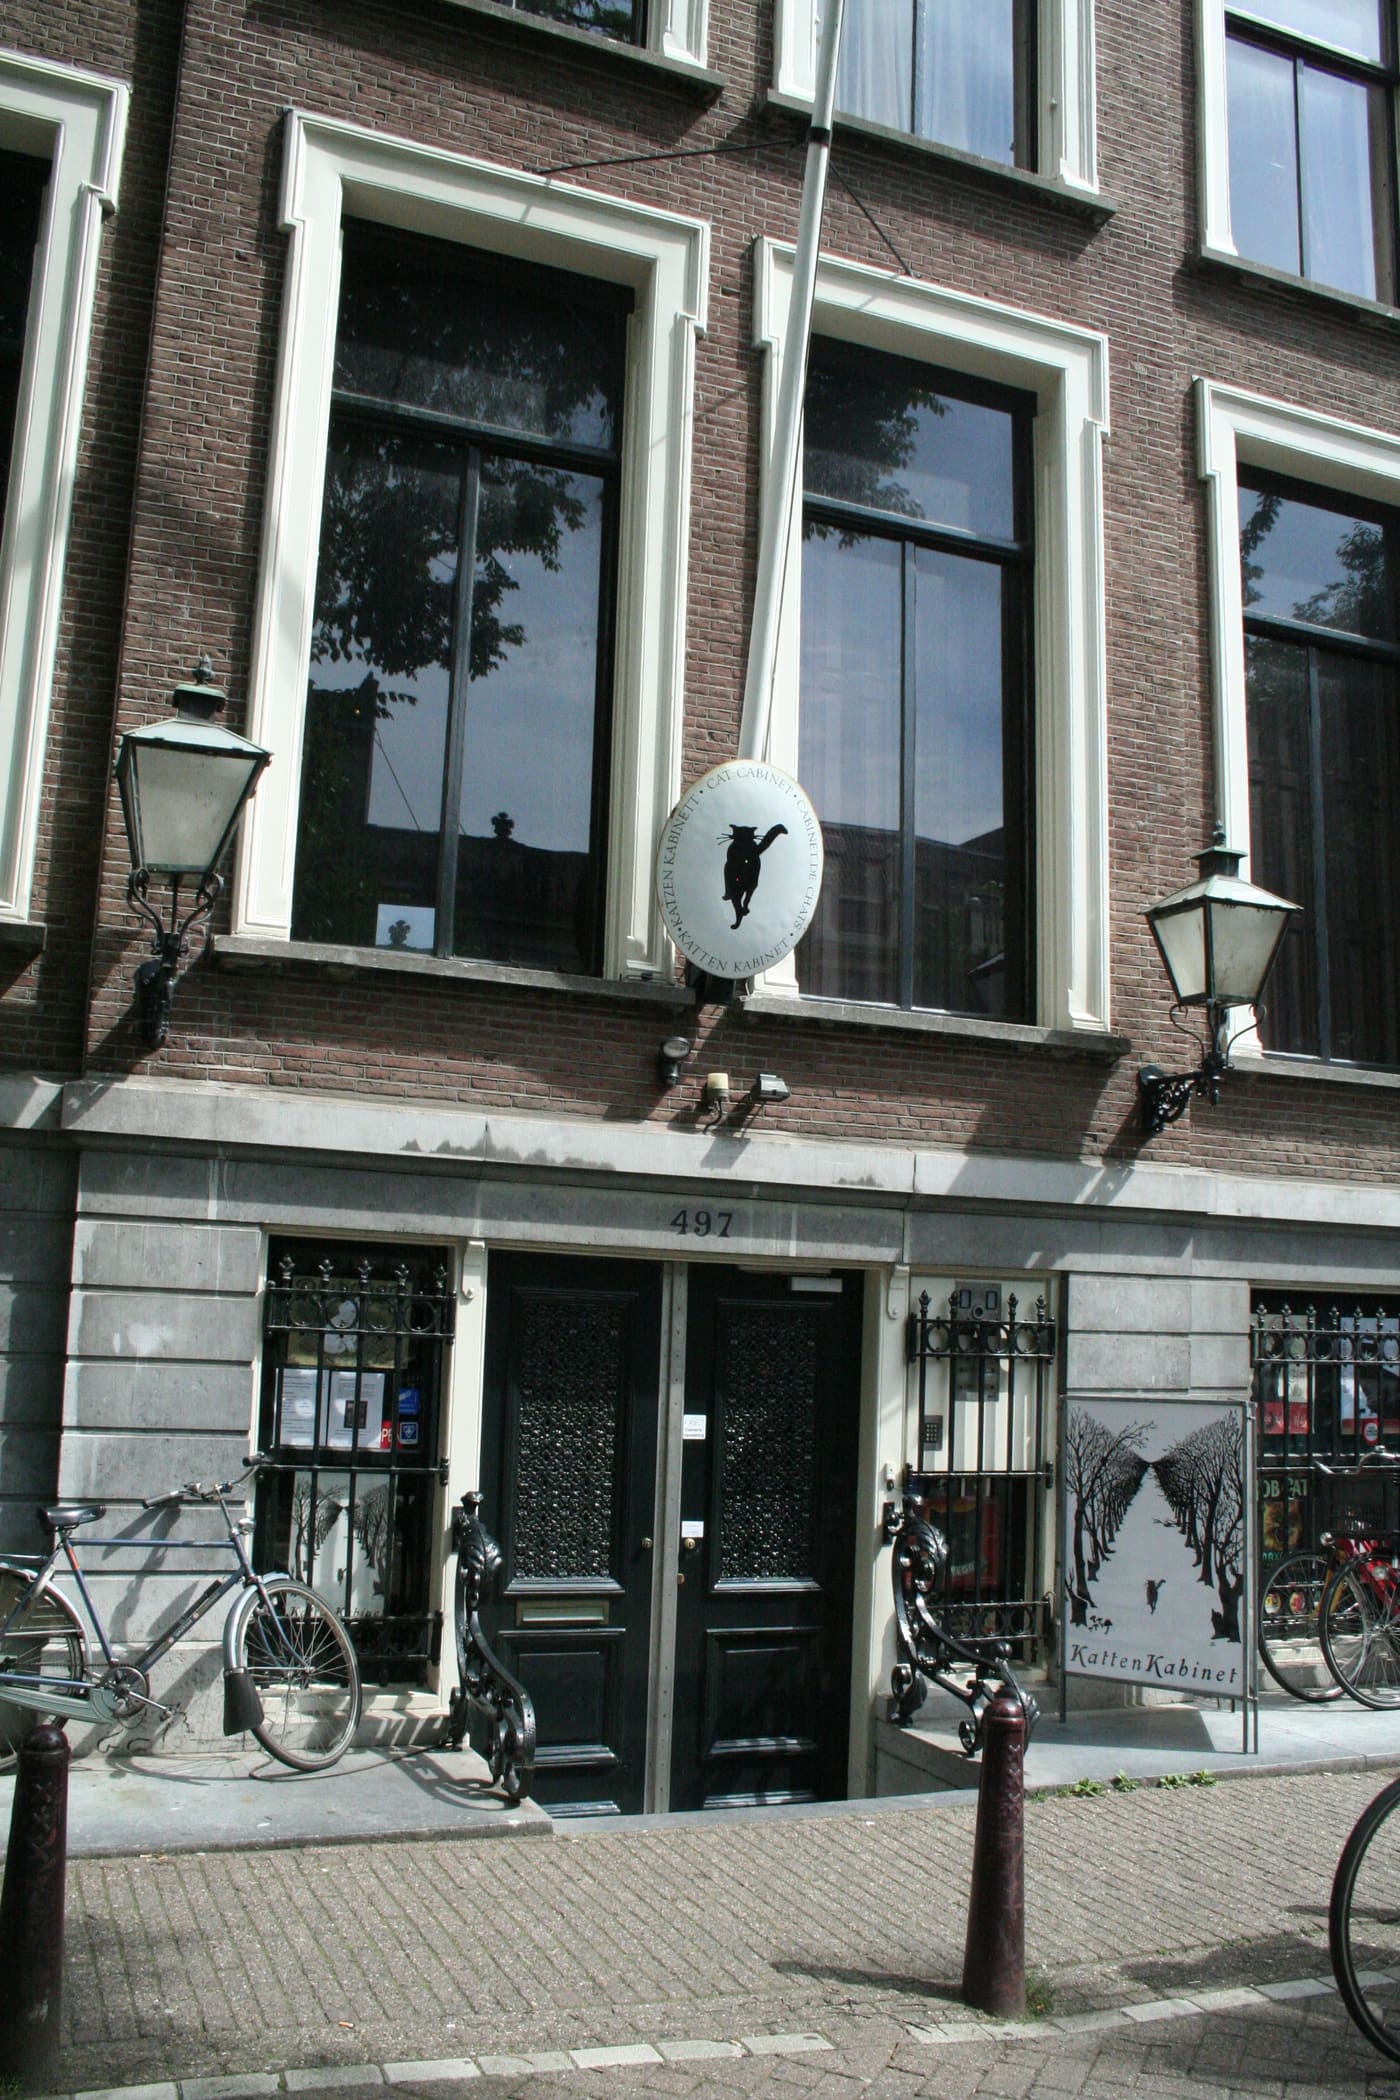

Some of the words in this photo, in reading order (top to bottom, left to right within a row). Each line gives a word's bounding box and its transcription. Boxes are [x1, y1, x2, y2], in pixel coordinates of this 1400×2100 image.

[706, 768, 731, 790] CAT
[736, 767, 794, 794] CABINET
[663, 795, 700, 866] KABINETT
[796, 799, 819, 857] CABINET
[808, 863, 819, 881] DE
[663, 870, 683, 928] KATZEN
[793, 886, 815, 930] CHATS
[678, 930, 729, 971] KATTEN
[734, 937, 789, 973] KABINET
[669, 1209, 734, 1239] 497
